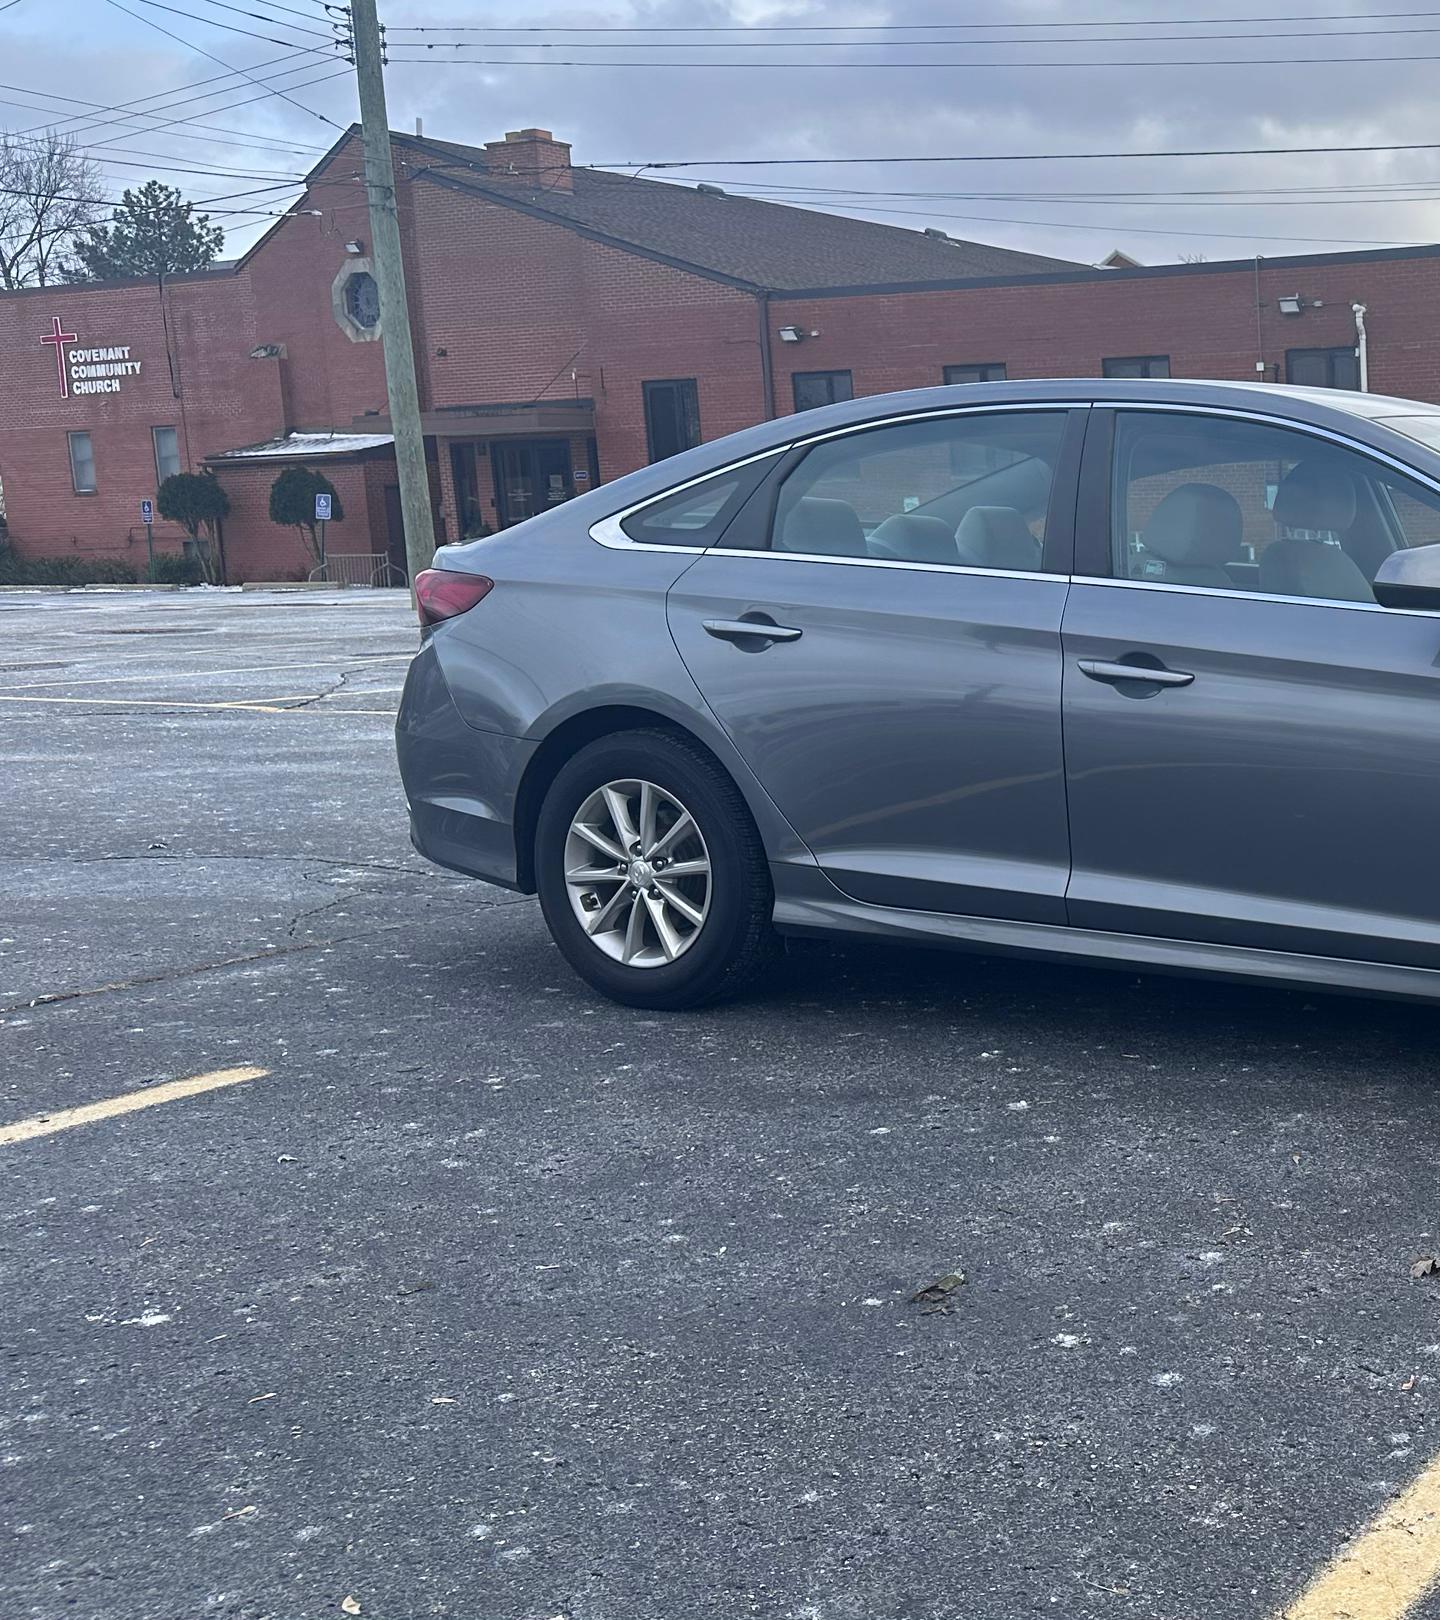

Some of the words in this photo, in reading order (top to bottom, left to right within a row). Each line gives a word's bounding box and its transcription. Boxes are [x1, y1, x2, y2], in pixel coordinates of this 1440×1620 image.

[69, 346, 130, 363] COVENANT
[71, 361, 141, 378] COMMUNITY
[73, 379, 120, 394] CHURCH
